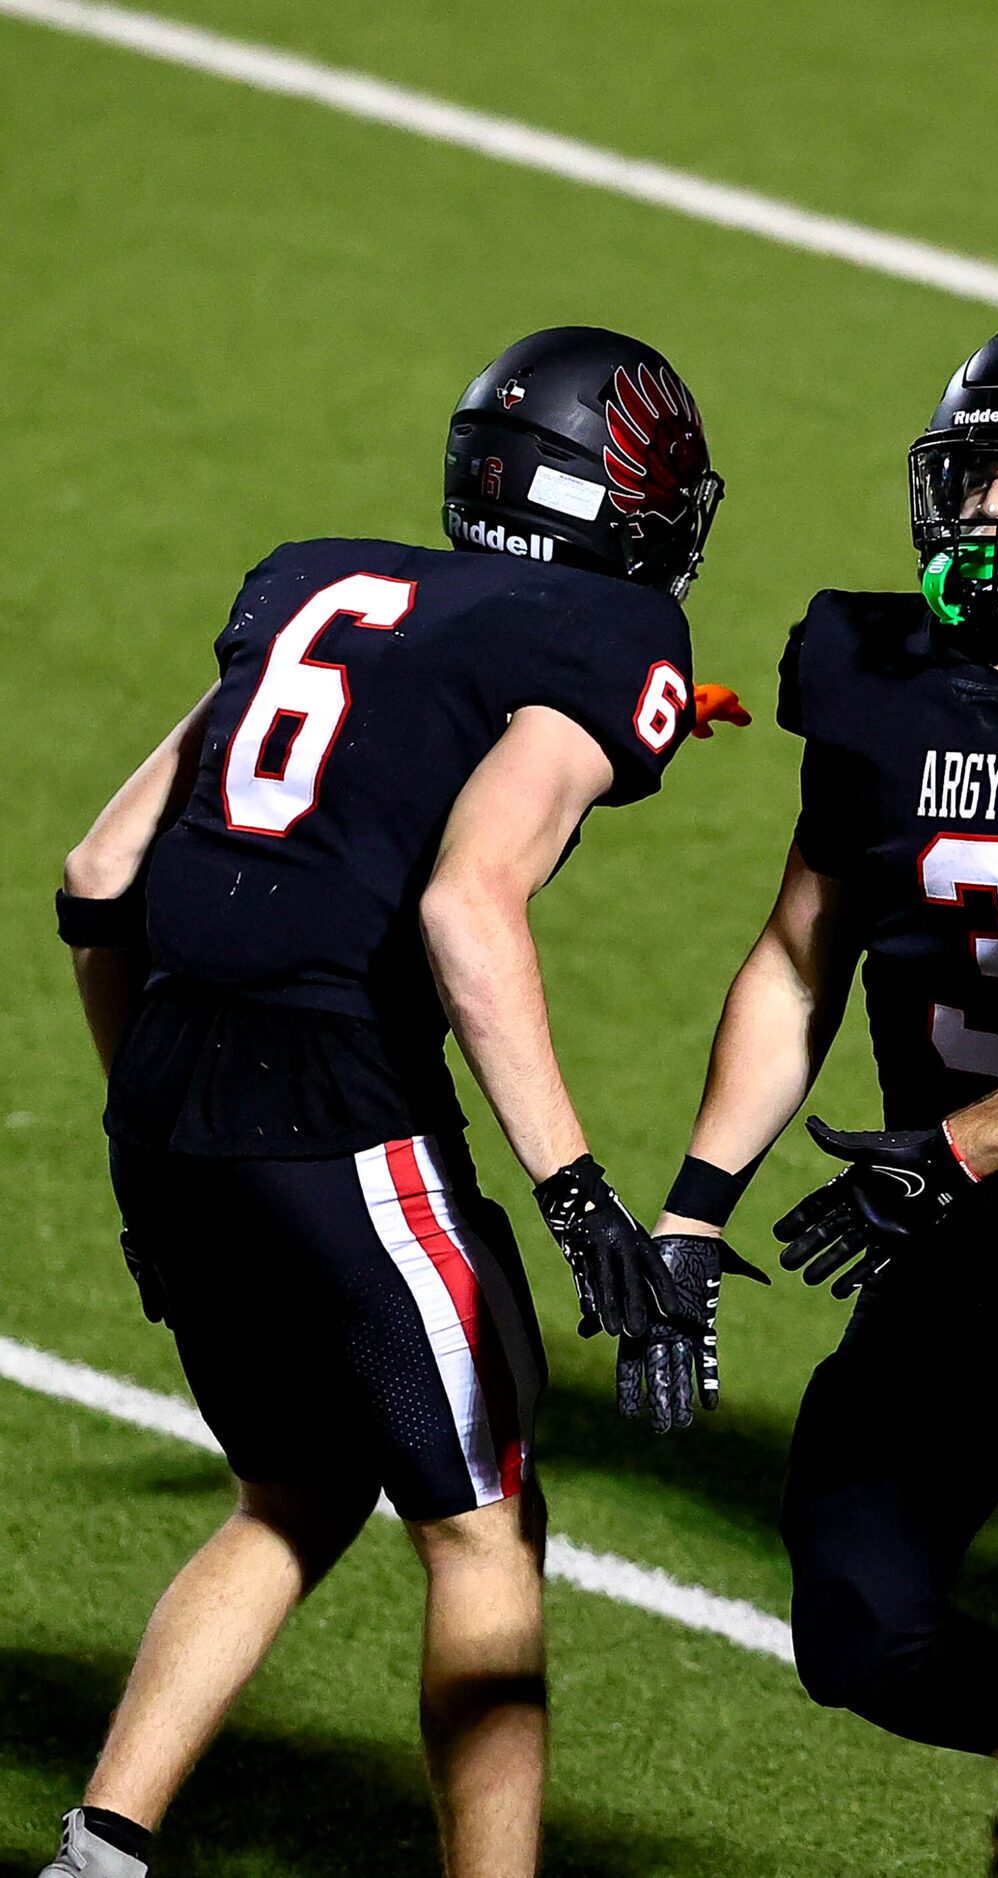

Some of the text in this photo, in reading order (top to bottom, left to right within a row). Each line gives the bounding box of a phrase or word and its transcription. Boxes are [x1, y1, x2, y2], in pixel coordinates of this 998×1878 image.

[448, 509, 554, 562] Riddell
[223, 572, 417, 837] 6
[633, 660, 687, 754] 6
